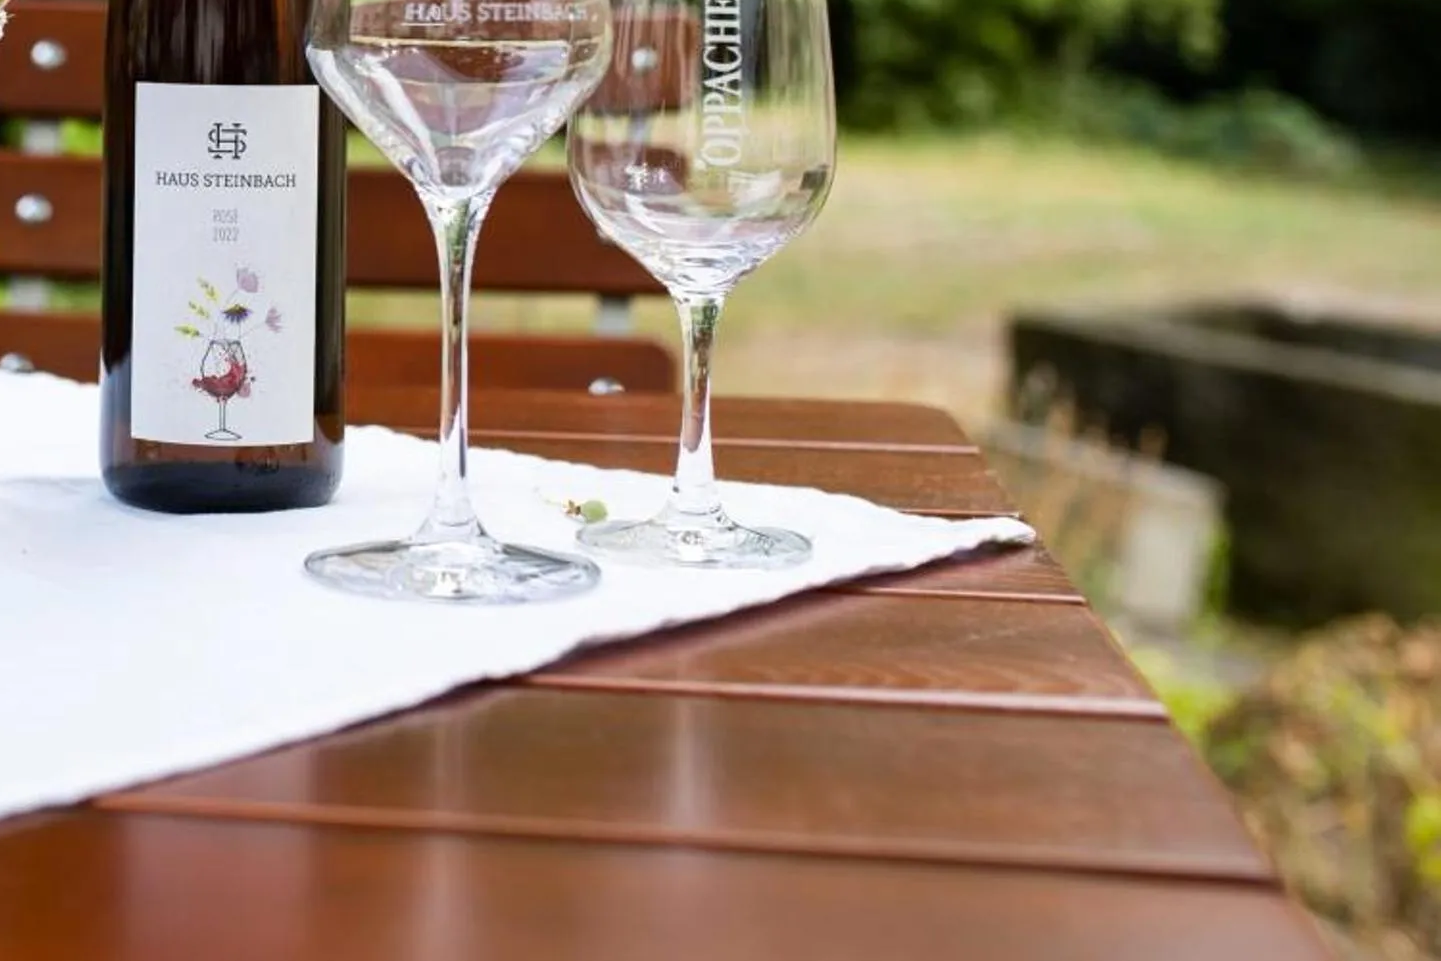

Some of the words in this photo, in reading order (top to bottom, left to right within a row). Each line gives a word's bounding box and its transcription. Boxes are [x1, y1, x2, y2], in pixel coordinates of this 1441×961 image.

[404, 2, 471, 22] HAUS
[477, 2, 587, 22] STEINBACH
[155, 170, 200, 188] HAUS
[203, 172, 297, 189] STEINBACH
